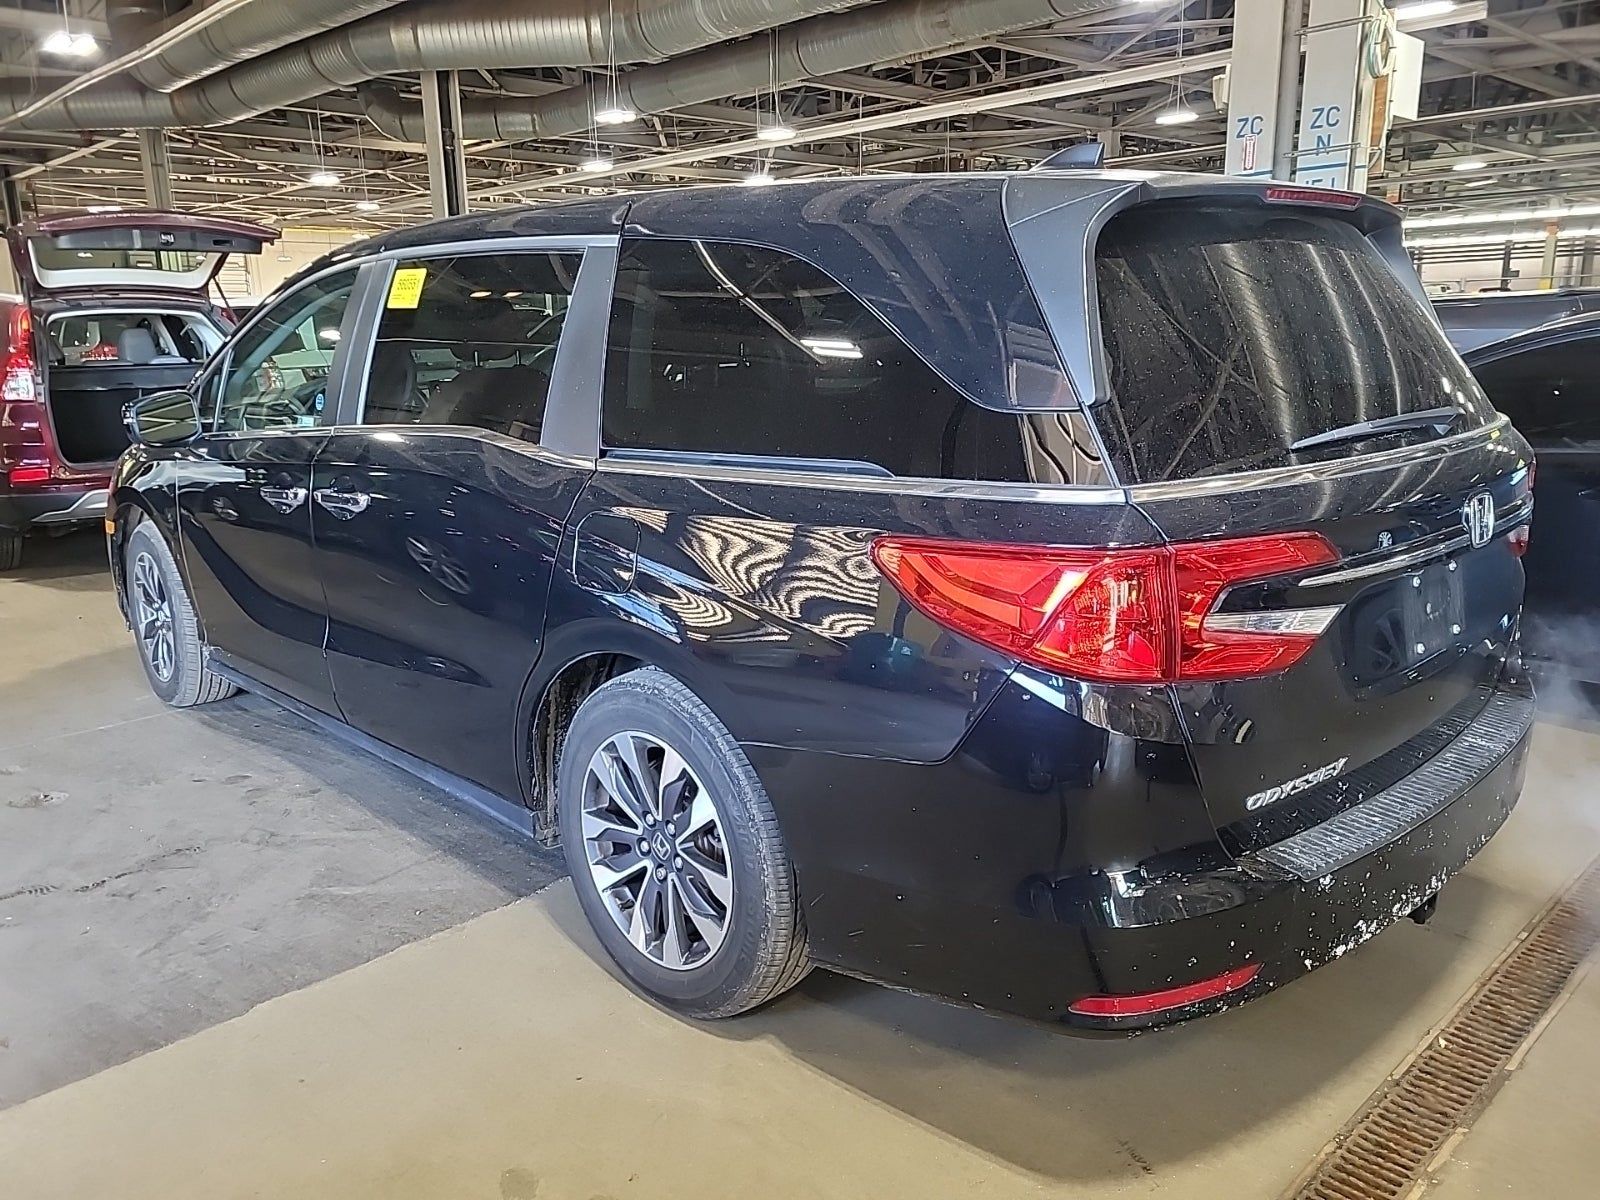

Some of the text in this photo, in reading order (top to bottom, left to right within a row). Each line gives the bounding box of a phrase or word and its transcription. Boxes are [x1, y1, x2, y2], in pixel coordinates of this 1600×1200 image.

[1236, 115, 1264, 139] ZC
[1310, 105, 1341, 130] ZC
[1315, 133, 1332, 156] N
